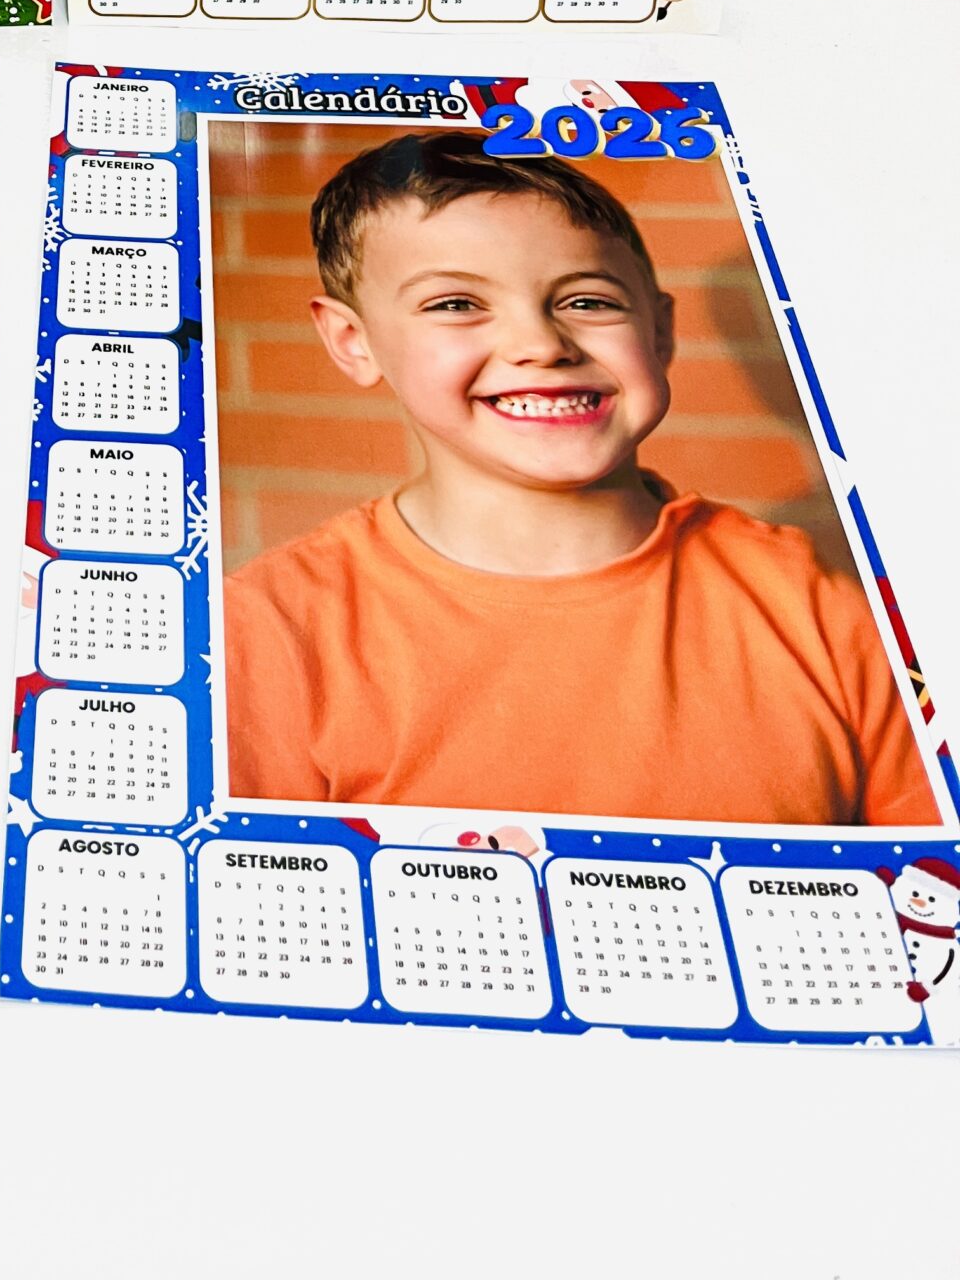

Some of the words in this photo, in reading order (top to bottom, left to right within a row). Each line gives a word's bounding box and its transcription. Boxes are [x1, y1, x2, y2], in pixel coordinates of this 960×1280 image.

[92, 82, 150, 93] JANEIRO
[236, 86, 467, 115] Calendário
[482, 107, 722, 161] 2026
[81, 158, 155, 171] FEVEREIRO
[91, 245, 147, 260] MARÇO
[91, 342, 135, 355] ABRIL
[89, 448, 135, 461] MAIO
[79, 568, 139, 583] JUNHO
[78, 698, 136, 714] JULHO
[58, 838, 140, 857] AGOSTO
[225, 852, 329, 873] SETEMBRO
[401, 861, 498, 882] OUTUBRO
[569, 870, 687, 892] NOVEMBRO
[748, 879, 859, 898] DEZEMBRO
